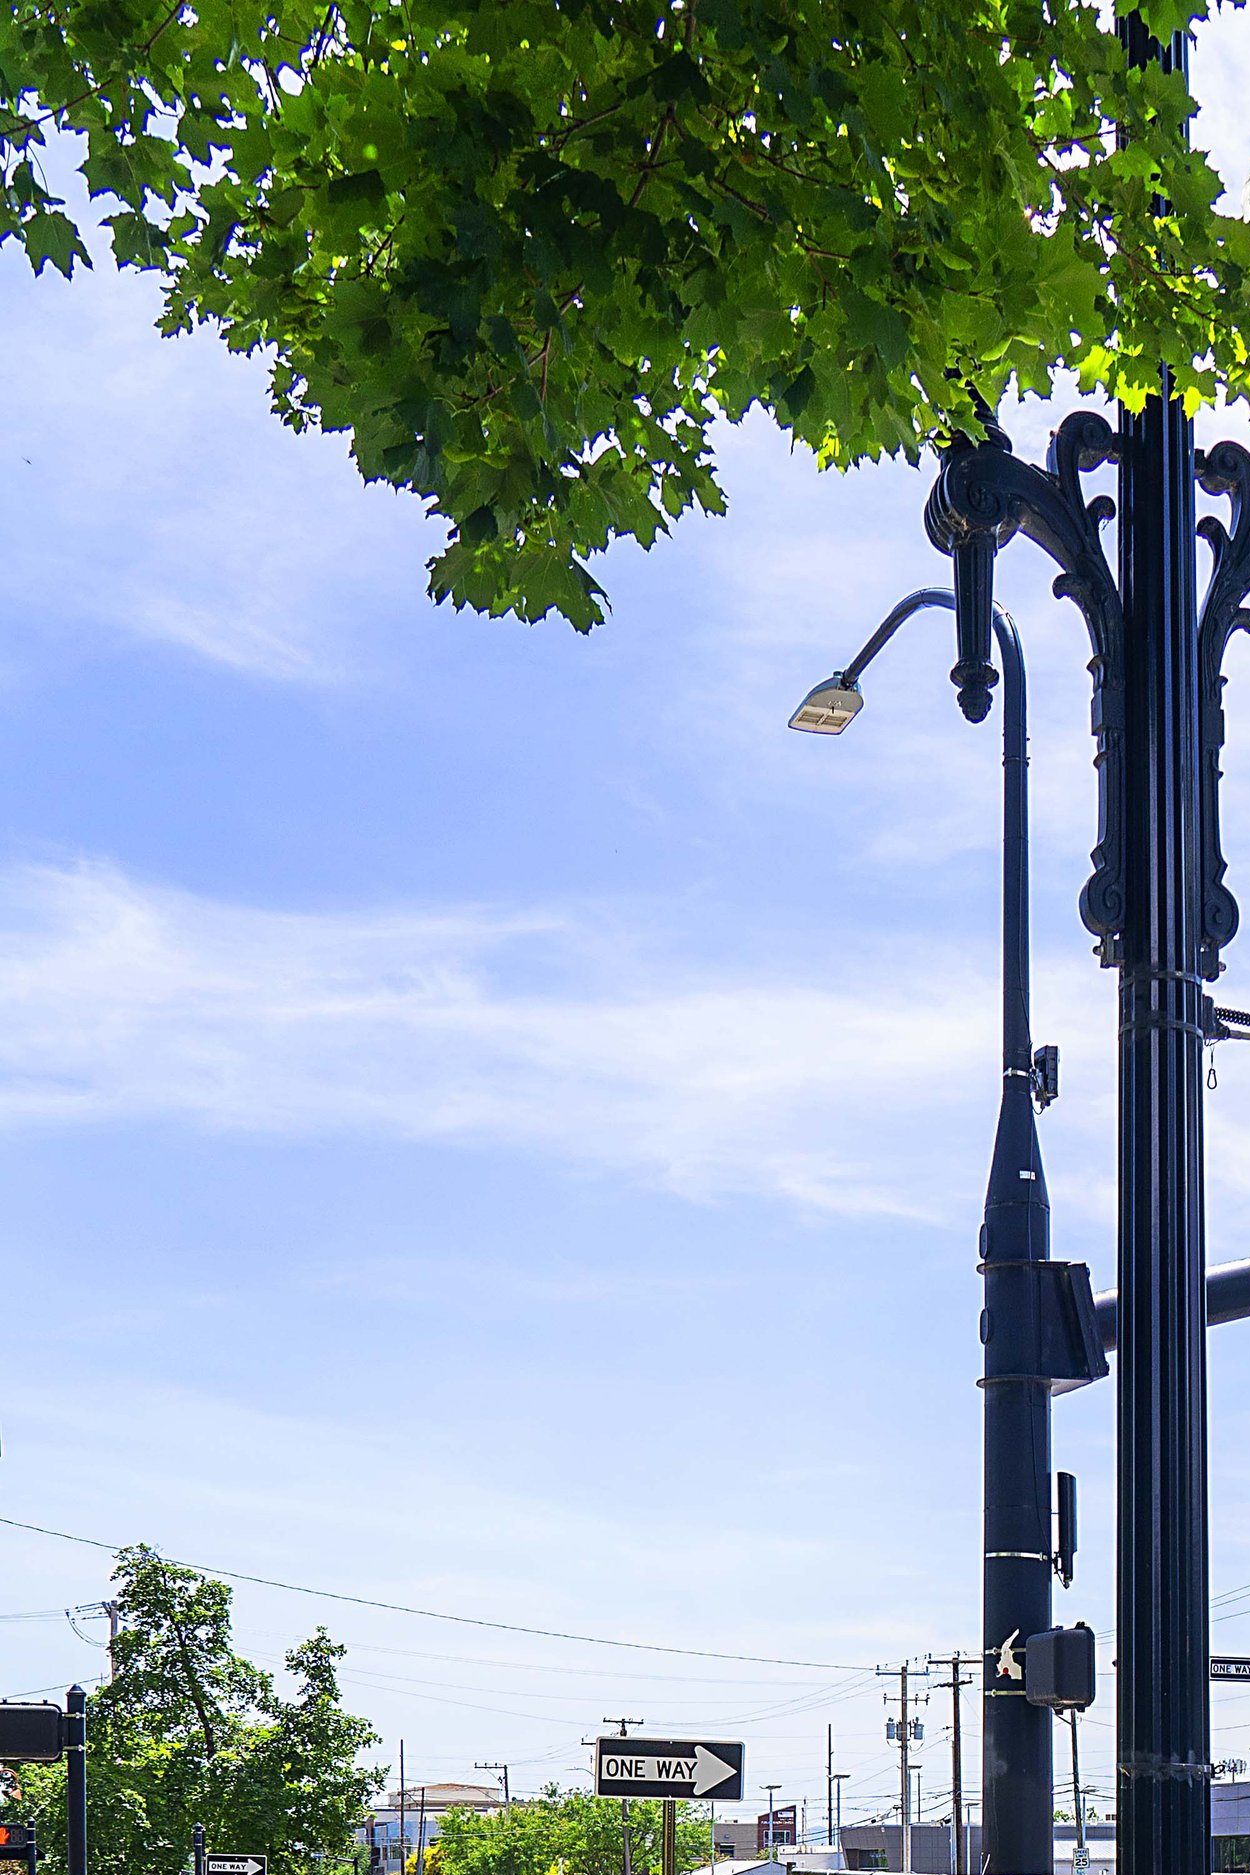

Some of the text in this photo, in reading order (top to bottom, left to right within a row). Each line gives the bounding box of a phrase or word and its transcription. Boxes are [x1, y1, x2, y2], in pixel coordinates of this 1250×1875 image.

[1213, 1664, 1231, 1673] ONE
[606, 1758, 698, 1779] ONE WAY
[1075, 1858, 1088, 1866] 25
